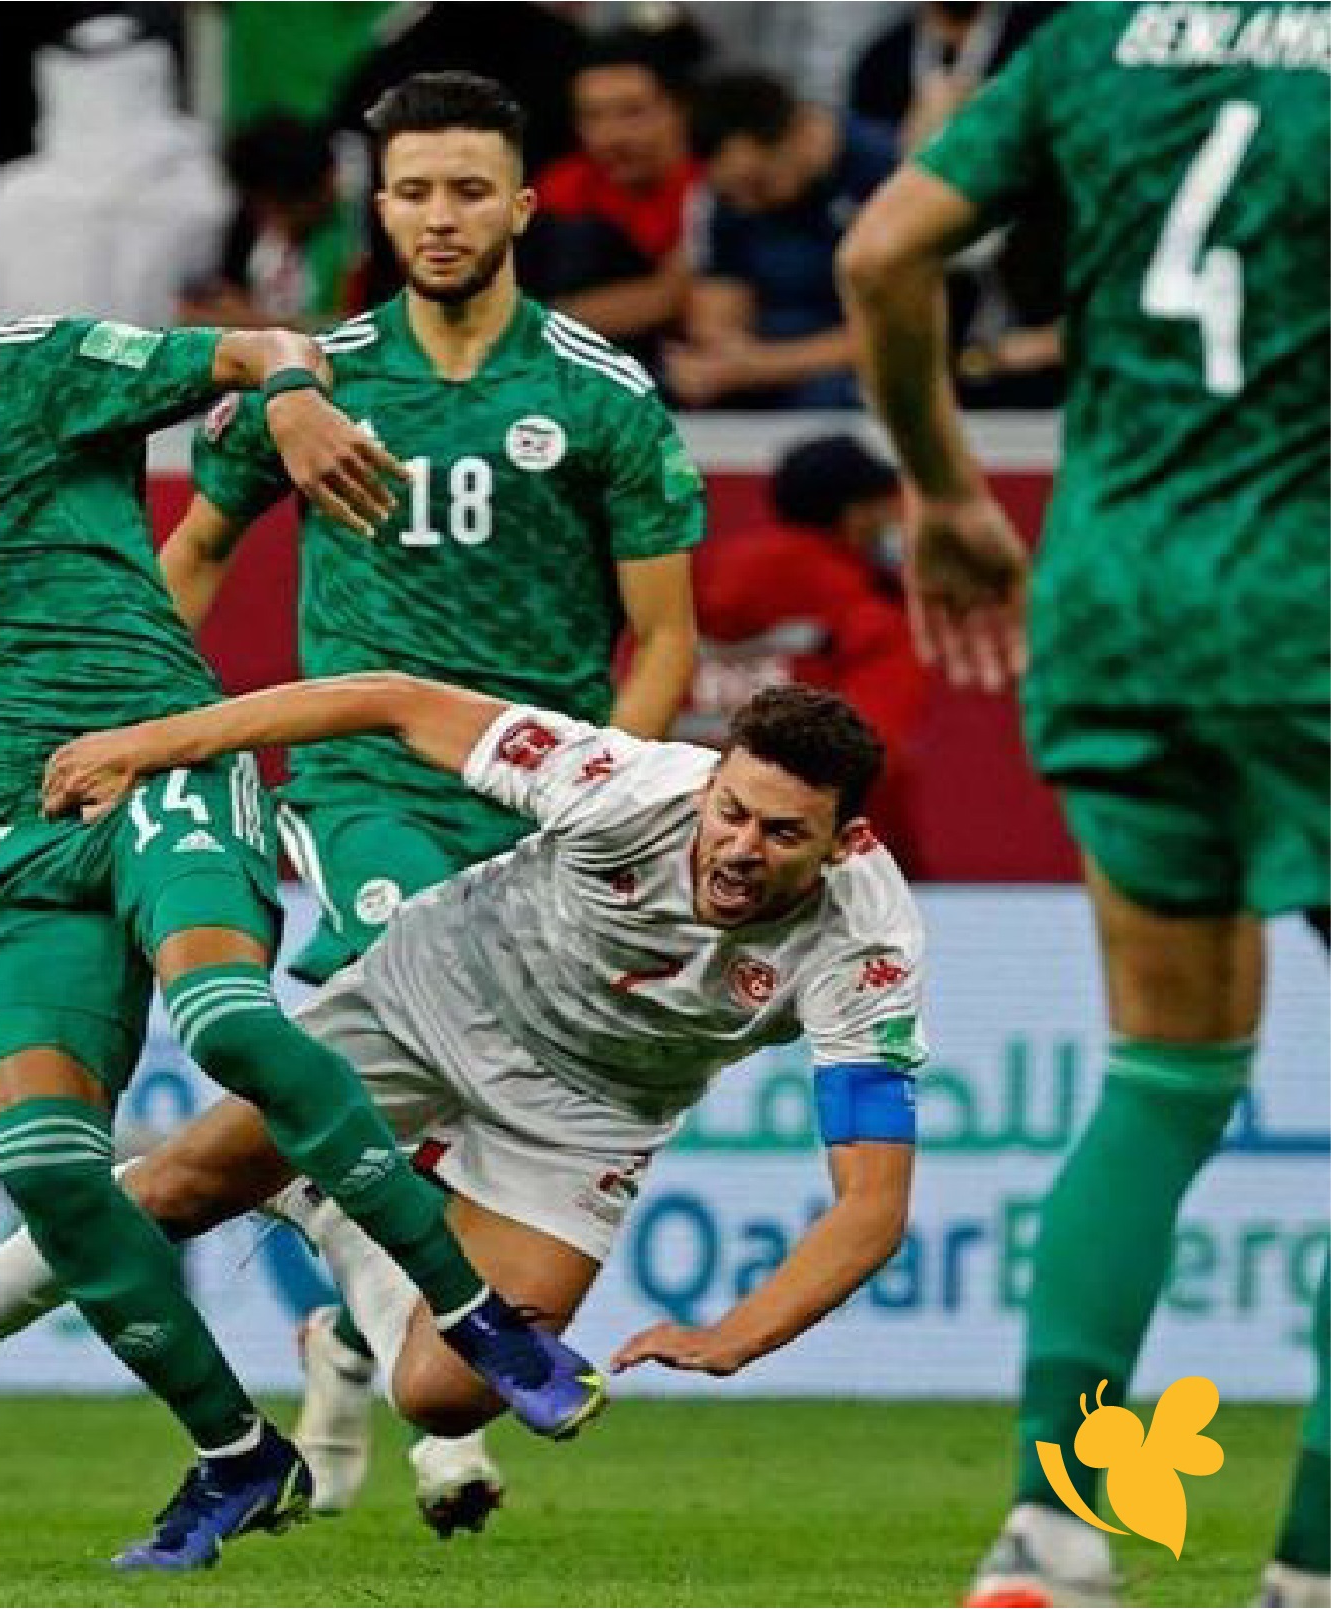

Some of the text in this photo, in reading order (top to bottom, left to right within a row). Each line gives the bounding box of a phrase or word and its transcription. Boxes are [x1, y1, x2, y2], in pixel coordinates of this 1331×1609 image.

[1141, 99, 1262, 397] 4
[399, 455, 494, 547] 18
[128, 768, 213, 855] 14
